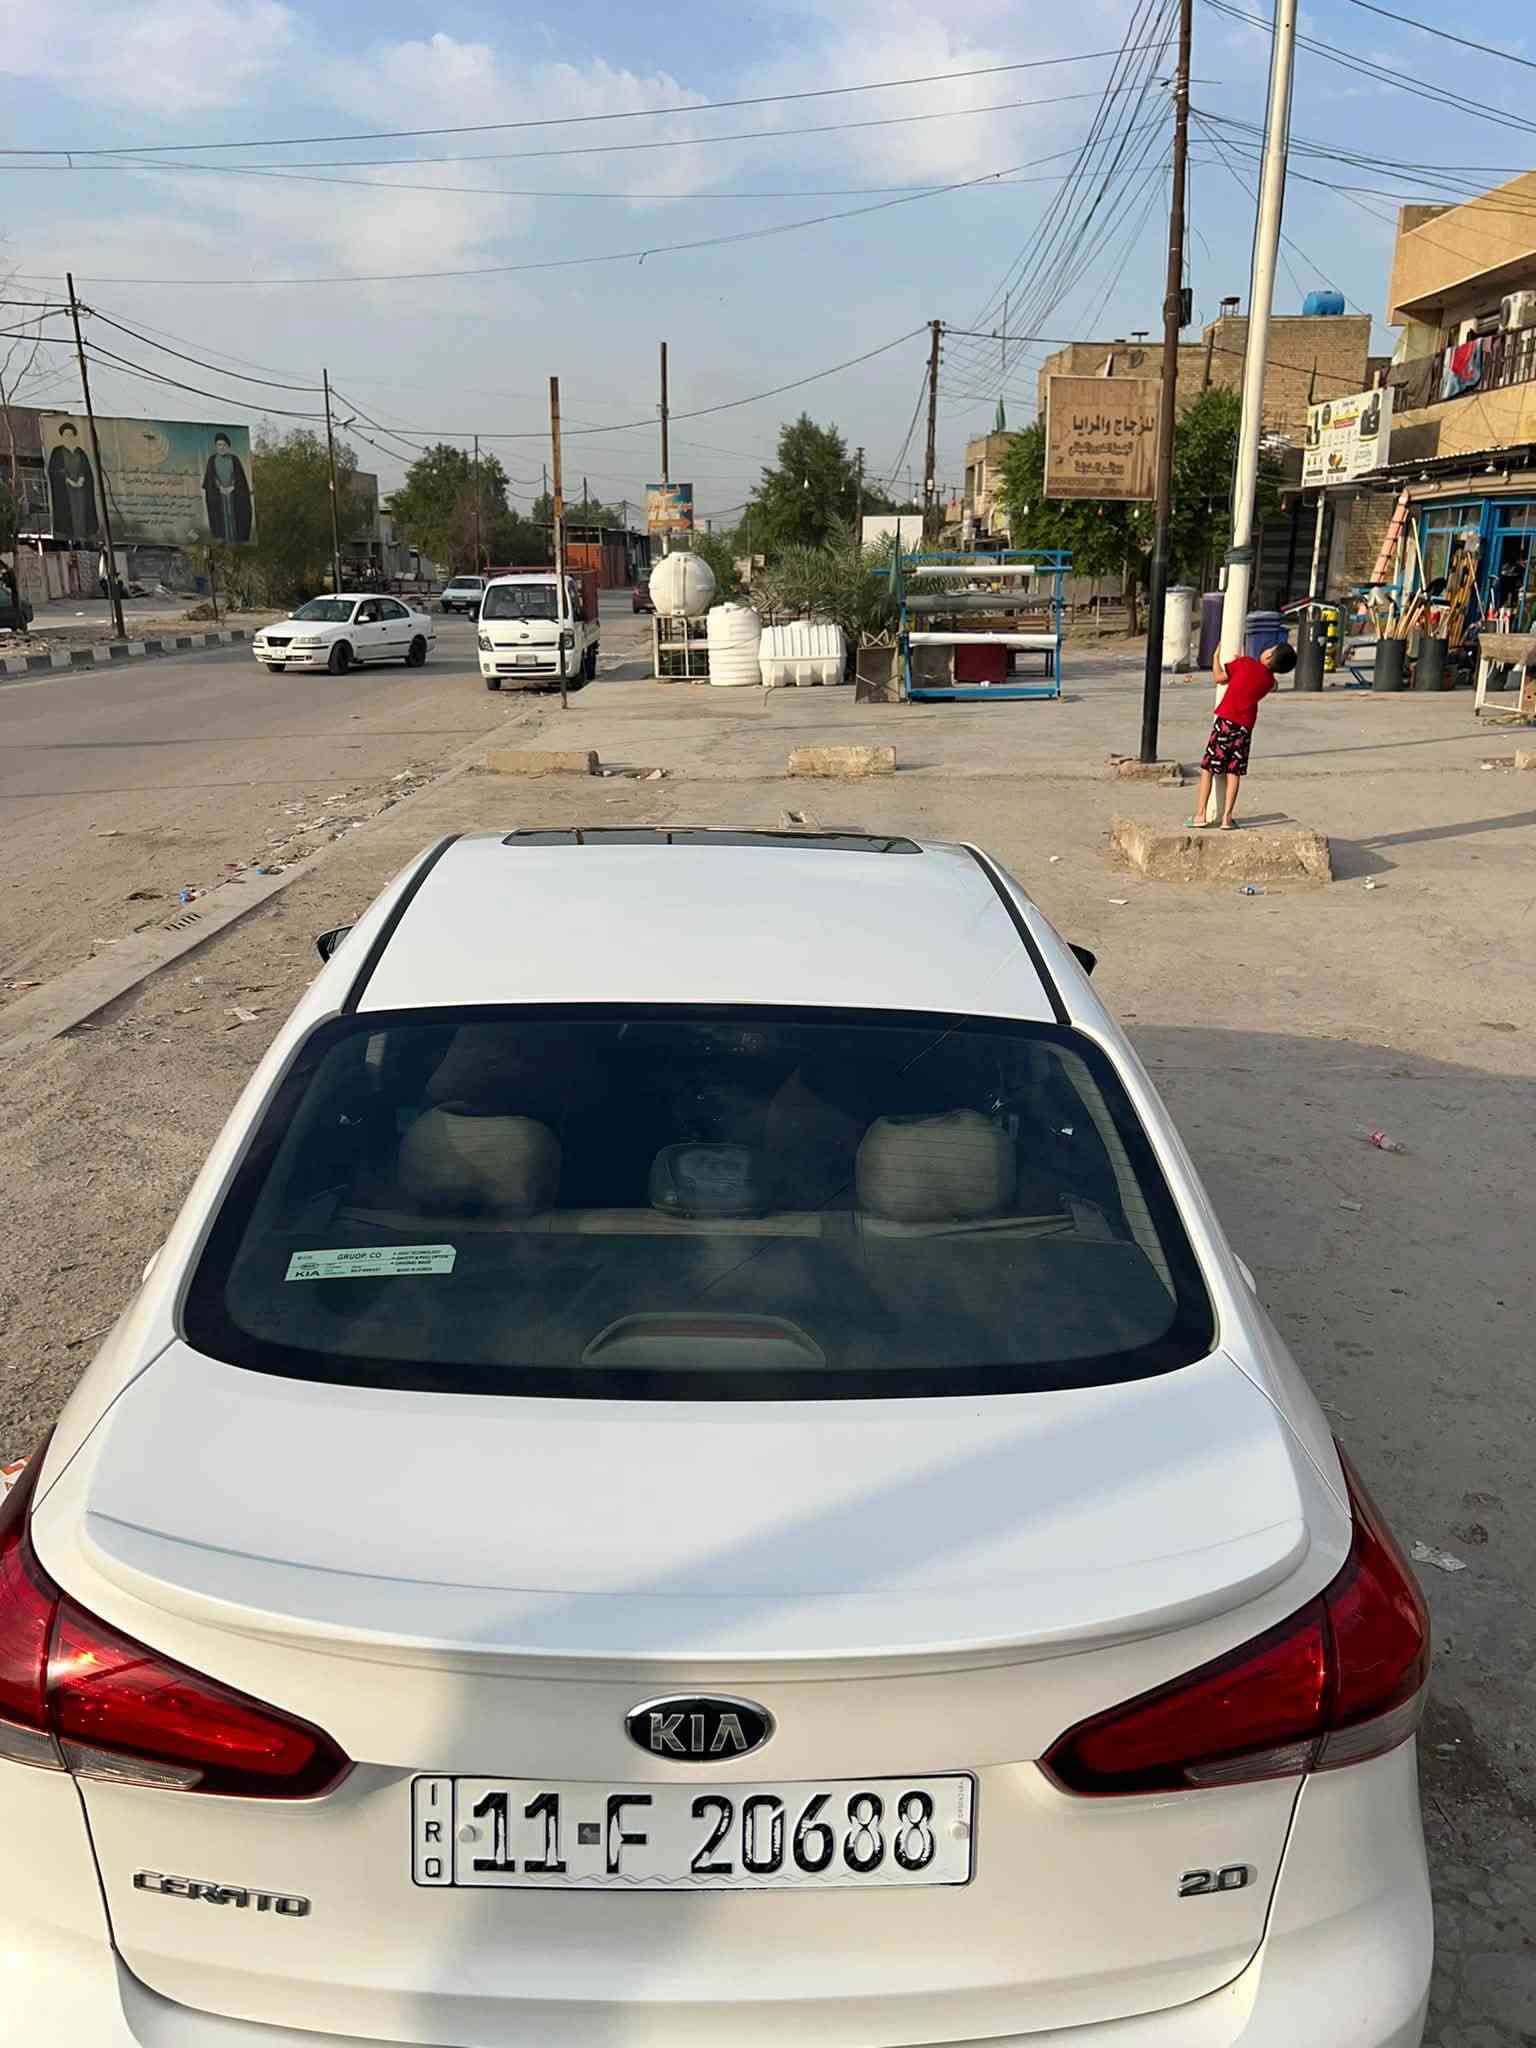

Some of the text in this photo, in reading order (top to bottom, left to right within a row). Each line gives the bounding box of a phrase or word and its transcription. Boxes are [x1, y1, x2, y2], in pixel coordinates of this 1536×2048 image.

[1072, 414, 1111, 437] والمرايا
[295, 1270, 320, 1278] KIA
[650, 1713, 748, 1752] KIA
[691, 1791, 935, 1874] 20688
[132, 1869, 312, 1917] CERATO
